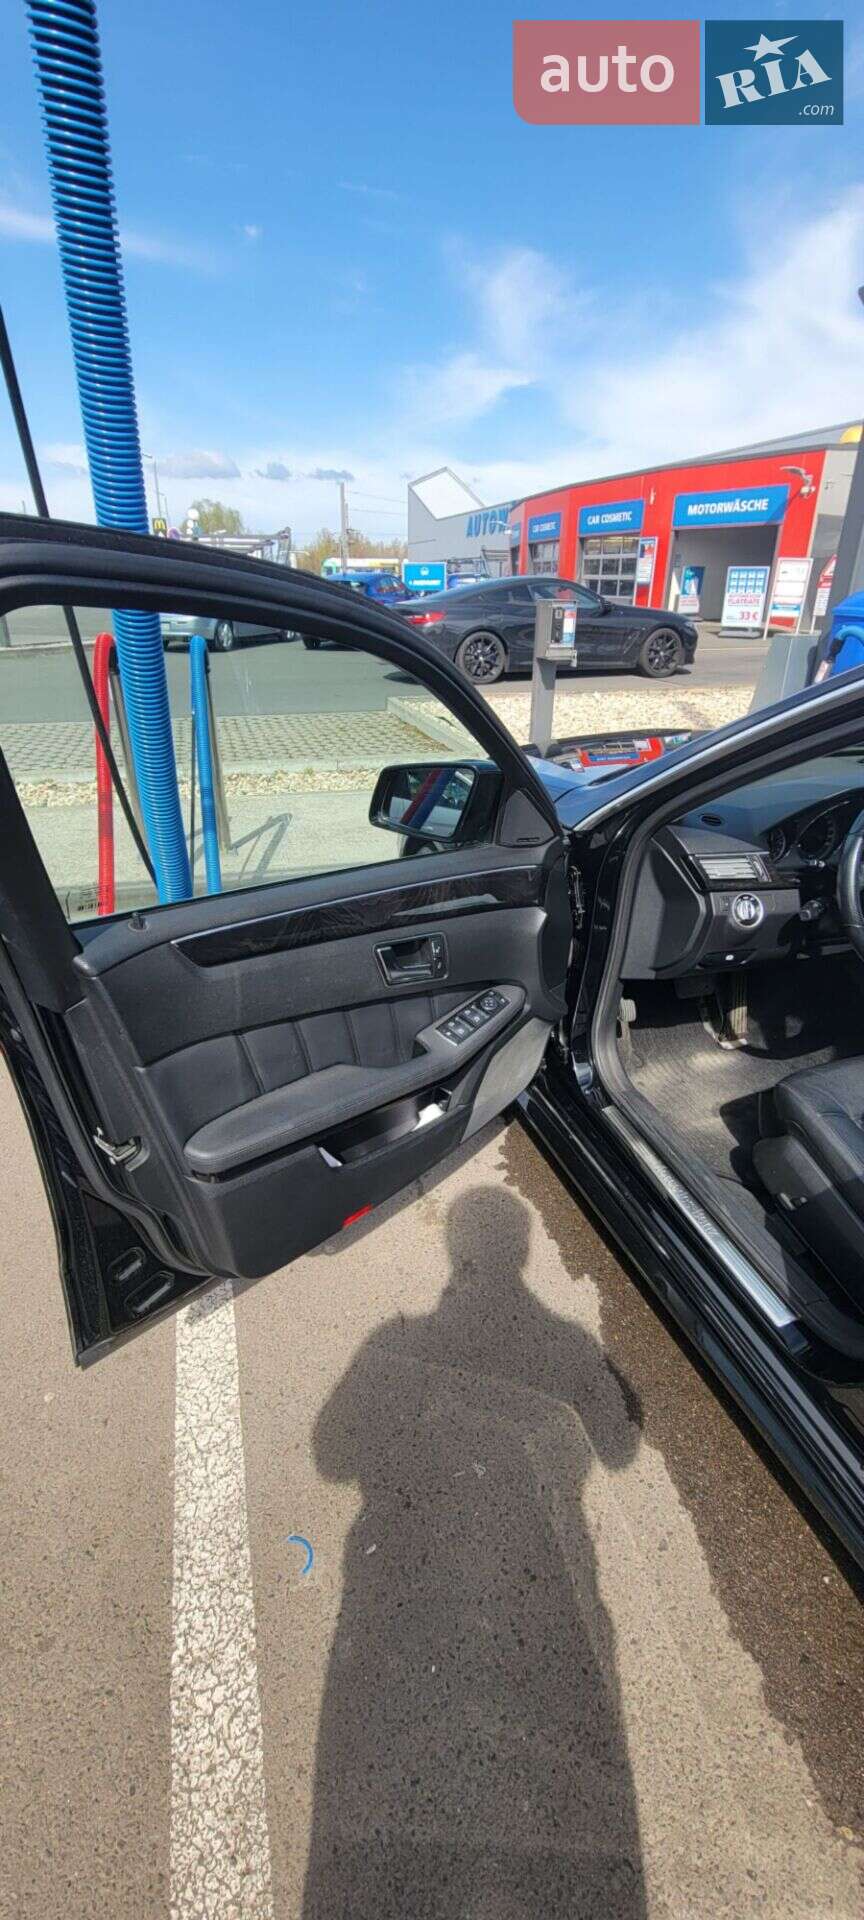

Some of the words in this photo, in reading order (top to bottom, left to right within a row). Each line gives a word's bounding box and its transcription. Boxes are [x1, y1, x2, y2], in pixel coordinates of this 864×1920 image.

[687, 498, 769, 516] MOTORWÄSCHE
[587, 515, 600, 525] CAR
[601, 511, 632, 524] COSMETIC
[739, 611, 750, 620] 33
